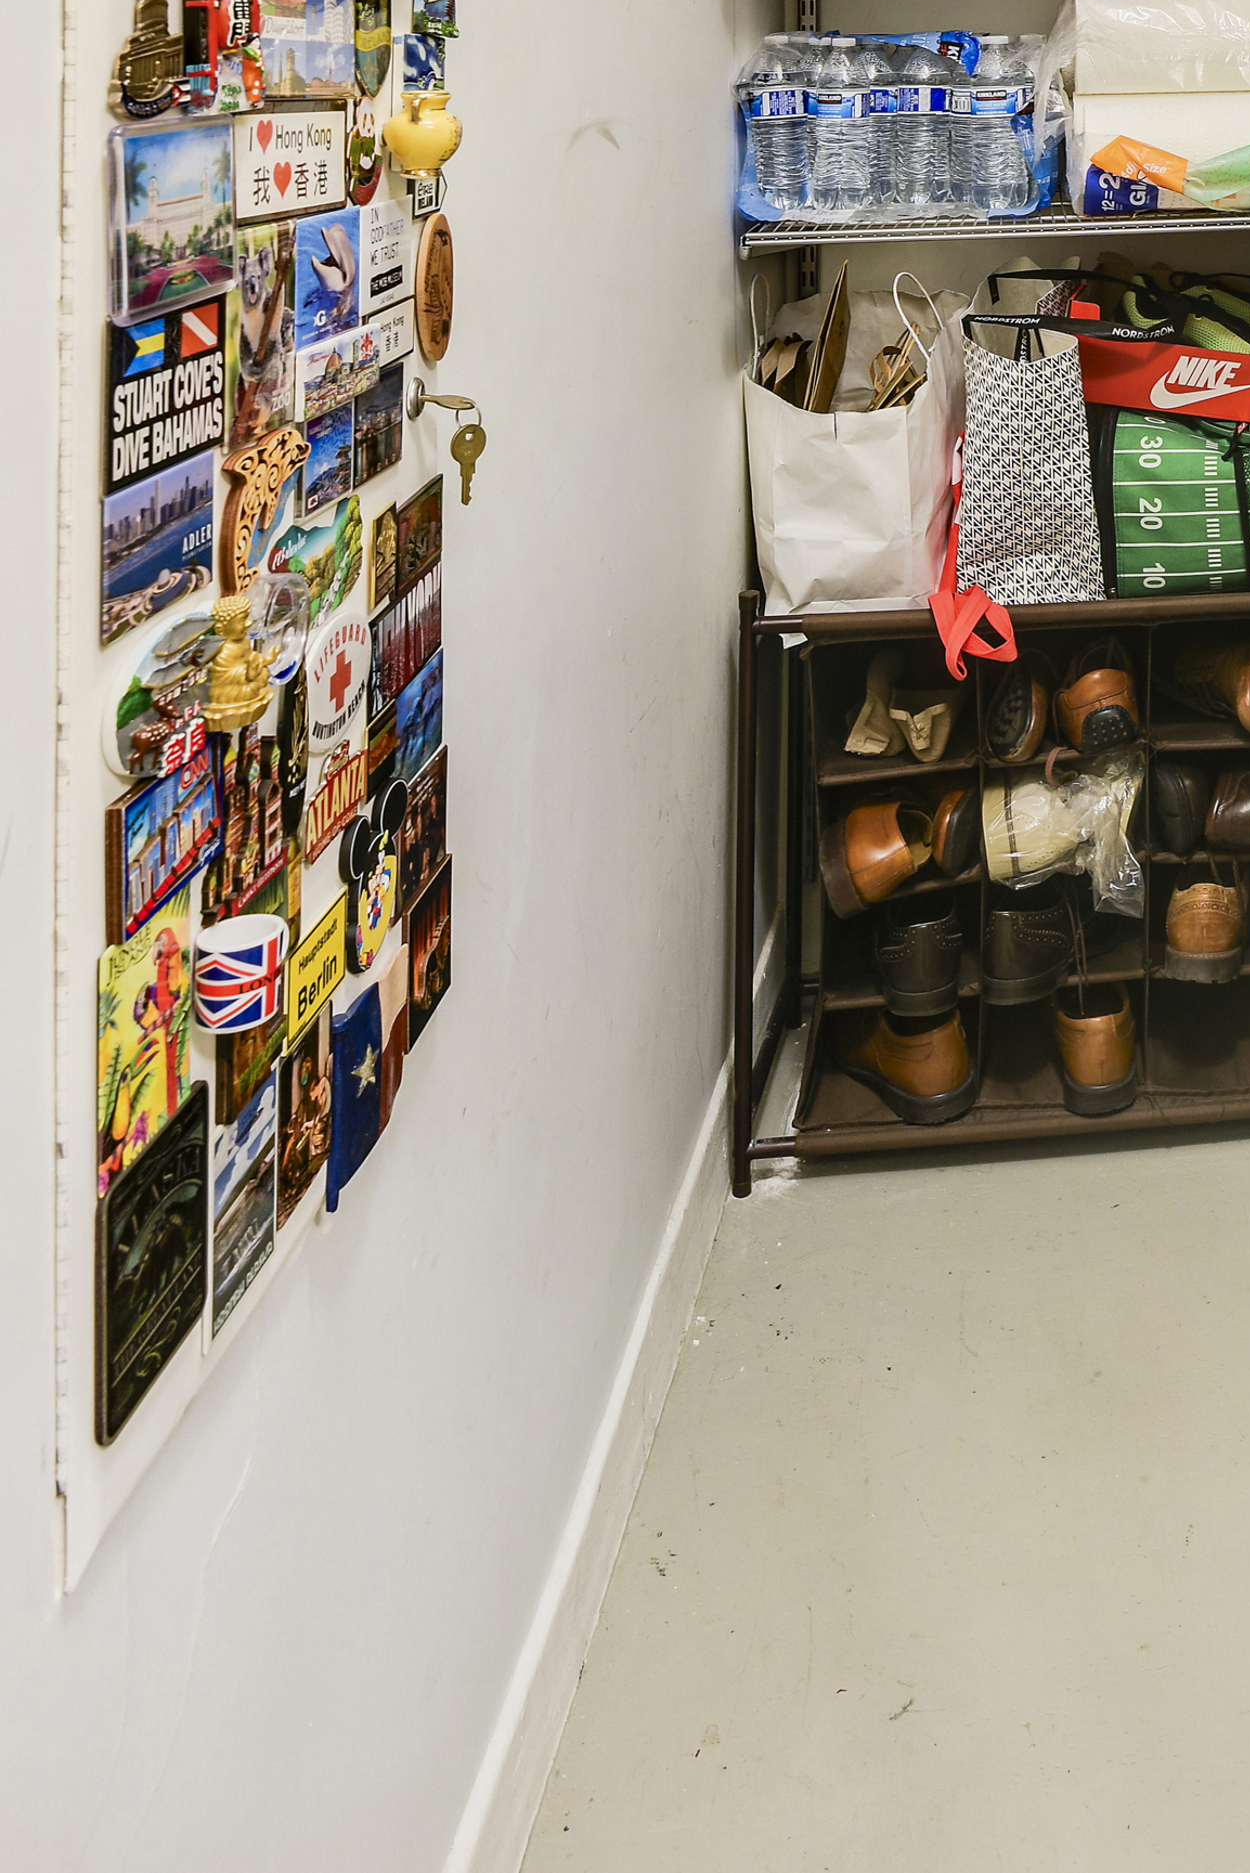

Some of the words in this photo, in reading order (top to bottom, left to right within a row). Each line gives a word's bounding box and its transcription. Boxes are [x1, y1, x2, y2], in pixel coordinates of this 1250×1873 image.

[275, 124, 304, 154] Hong
[306, 123, 332, 149] Kong
[253, 165, 270, 207] 我
[294, 158, 328, 201] 香港
[1142, 162, 1166, 175] Size
[370, 207, 380, 224] IN
[370, 218, 405, 244] GODFATHER
[370, 250, 380, 267] WE
[380, 241, 399, 261] TRUST
[973, 316, 1041, 325] NORDSTROM
[1111, 324, 1175, 340] NORDSTROM
[1166, 355, 1242, 390] NIKE
[113, 369, 172, 433] STUART
[173, 350, 223, 409] COVE'S
[272, 391, 291, 413] ZOO
[112, 425, 150, 482] DIVE
[151, 397, 223, 466] BAHAMAS
[1138, 435, 1164, 469] 30
[1139, 497, 1163, 530] 20
[182, 523, 212, 554] ADLER
[1142, 562, 1166, 589] 10
[313, 622, 366, 685] LIFEGUARD
[311, 714, 347, 740] HUNTINGTON
[347, 679, 366, 717] BEACH
[180, 747, 209, 791] CNN
[306, 752, 365, 848] ATLANTA
[298, 916, 339, 976] Hauptstadt
[297, 954, 338, 1021] Berlin
